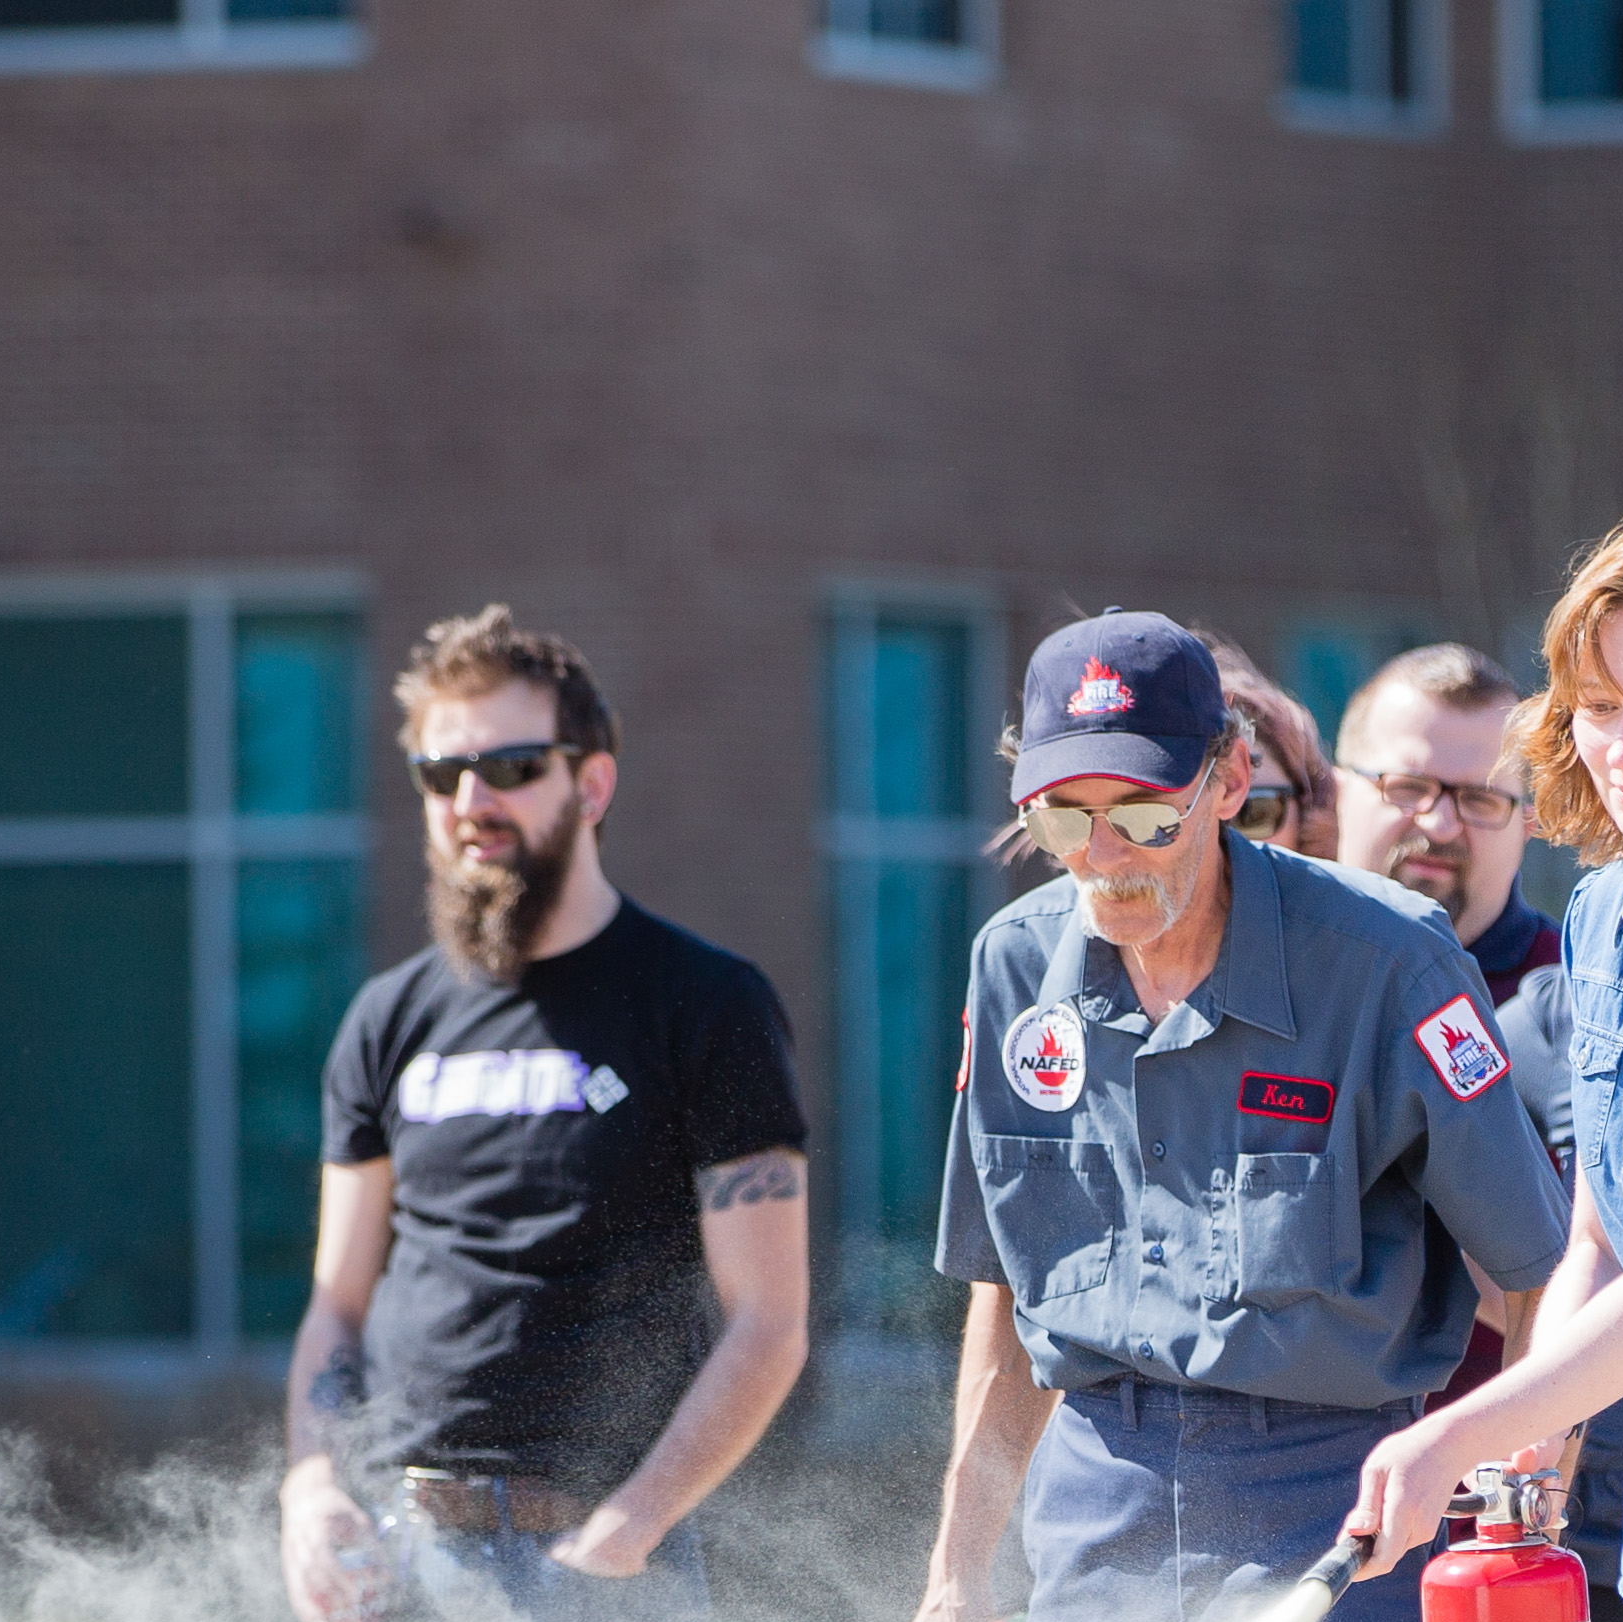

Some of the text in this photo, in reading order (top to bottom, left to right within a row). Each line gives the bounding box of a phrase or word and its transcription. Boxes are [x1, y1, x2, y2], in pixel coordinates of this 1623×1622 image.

[1010, 1017, 1035, 1060] ASSOCIATION
[1020, 1056, 1079, 1071] NAFED
[1455, 1044, 1483, 1071] FIRE
[1011, 1063, 1031, 1096] NATIONAL
[1261, 1084, 1305, 1110] Ken
